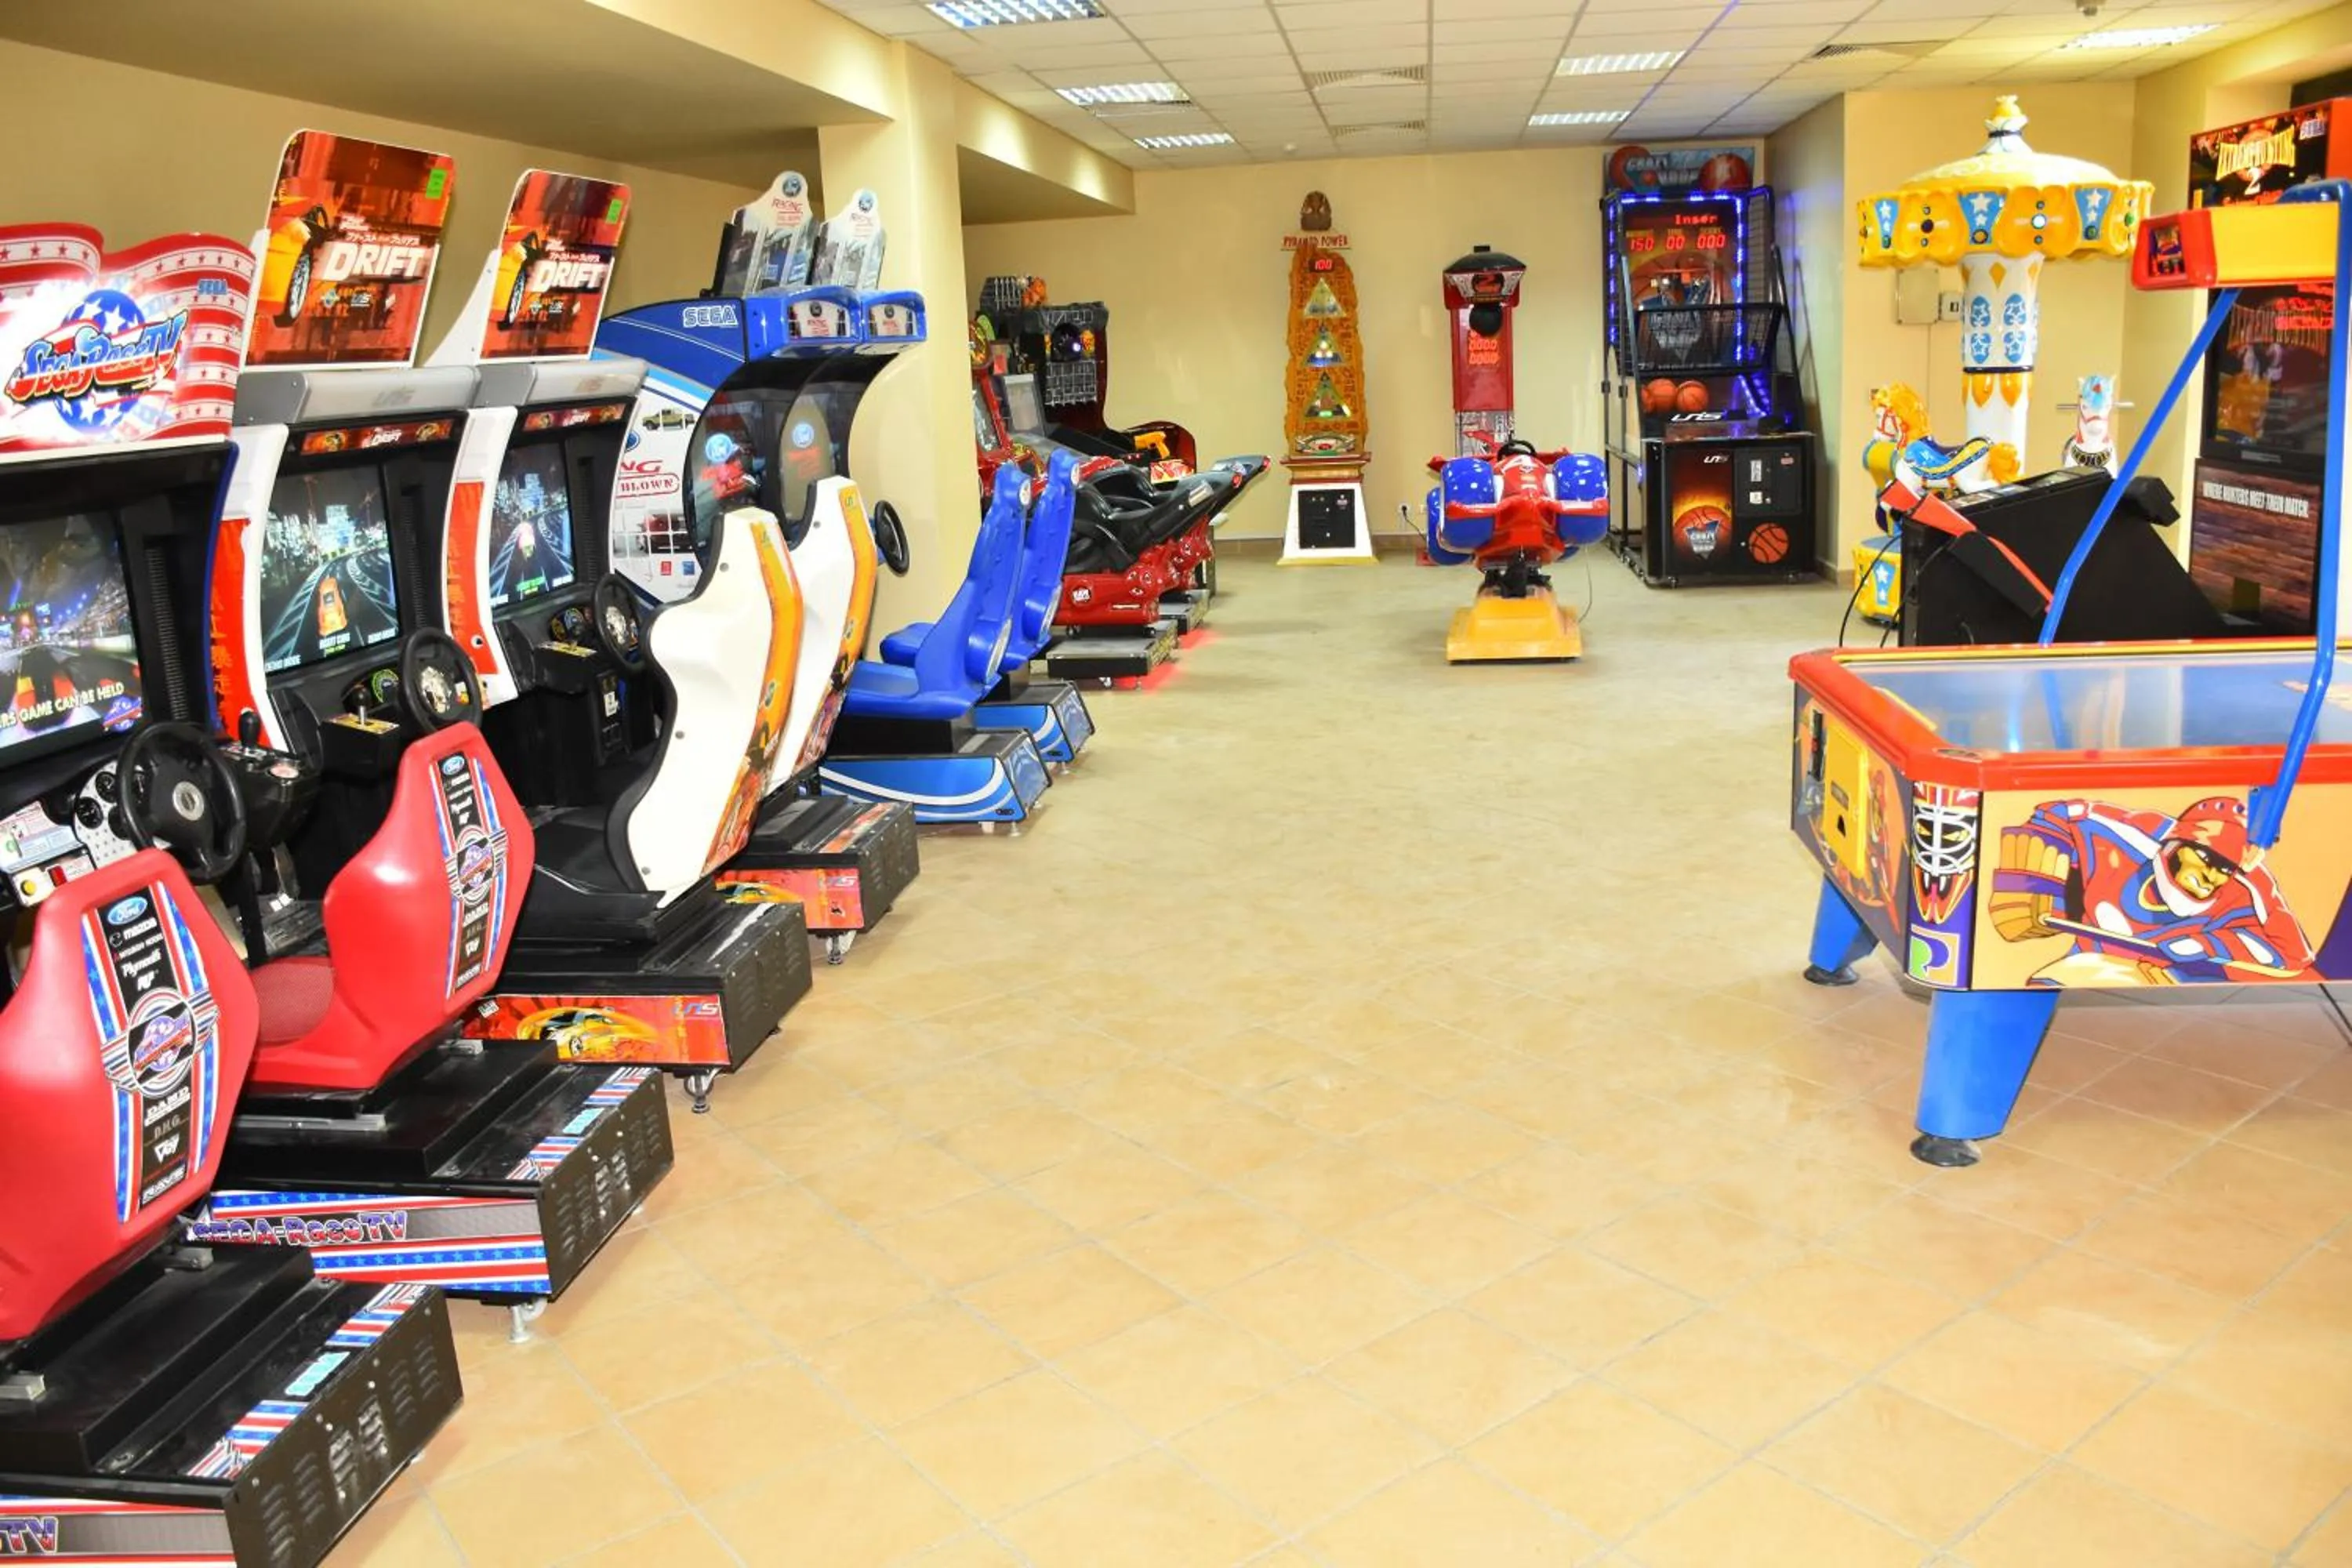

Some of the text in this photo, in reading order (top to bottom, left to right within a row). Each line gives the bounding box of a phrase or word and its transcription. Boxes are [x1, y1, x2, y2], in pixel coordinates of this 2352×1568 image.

[2245, 167, 2262, 196] 2
[322, 242, 426, 281] DRIFT
[532, 260, 604, 293] DRIFT
[683, 305, 739, 328] SEGA
[620, 478, 674, 492] BLOWN
[19, 699, 54, 722] GAME
[54, 692, 79, 713] CAN
[80, 688, 96, 705] BE
[96, 681, 125, 700] HELD
[107, 895, 147, 925] Ford
